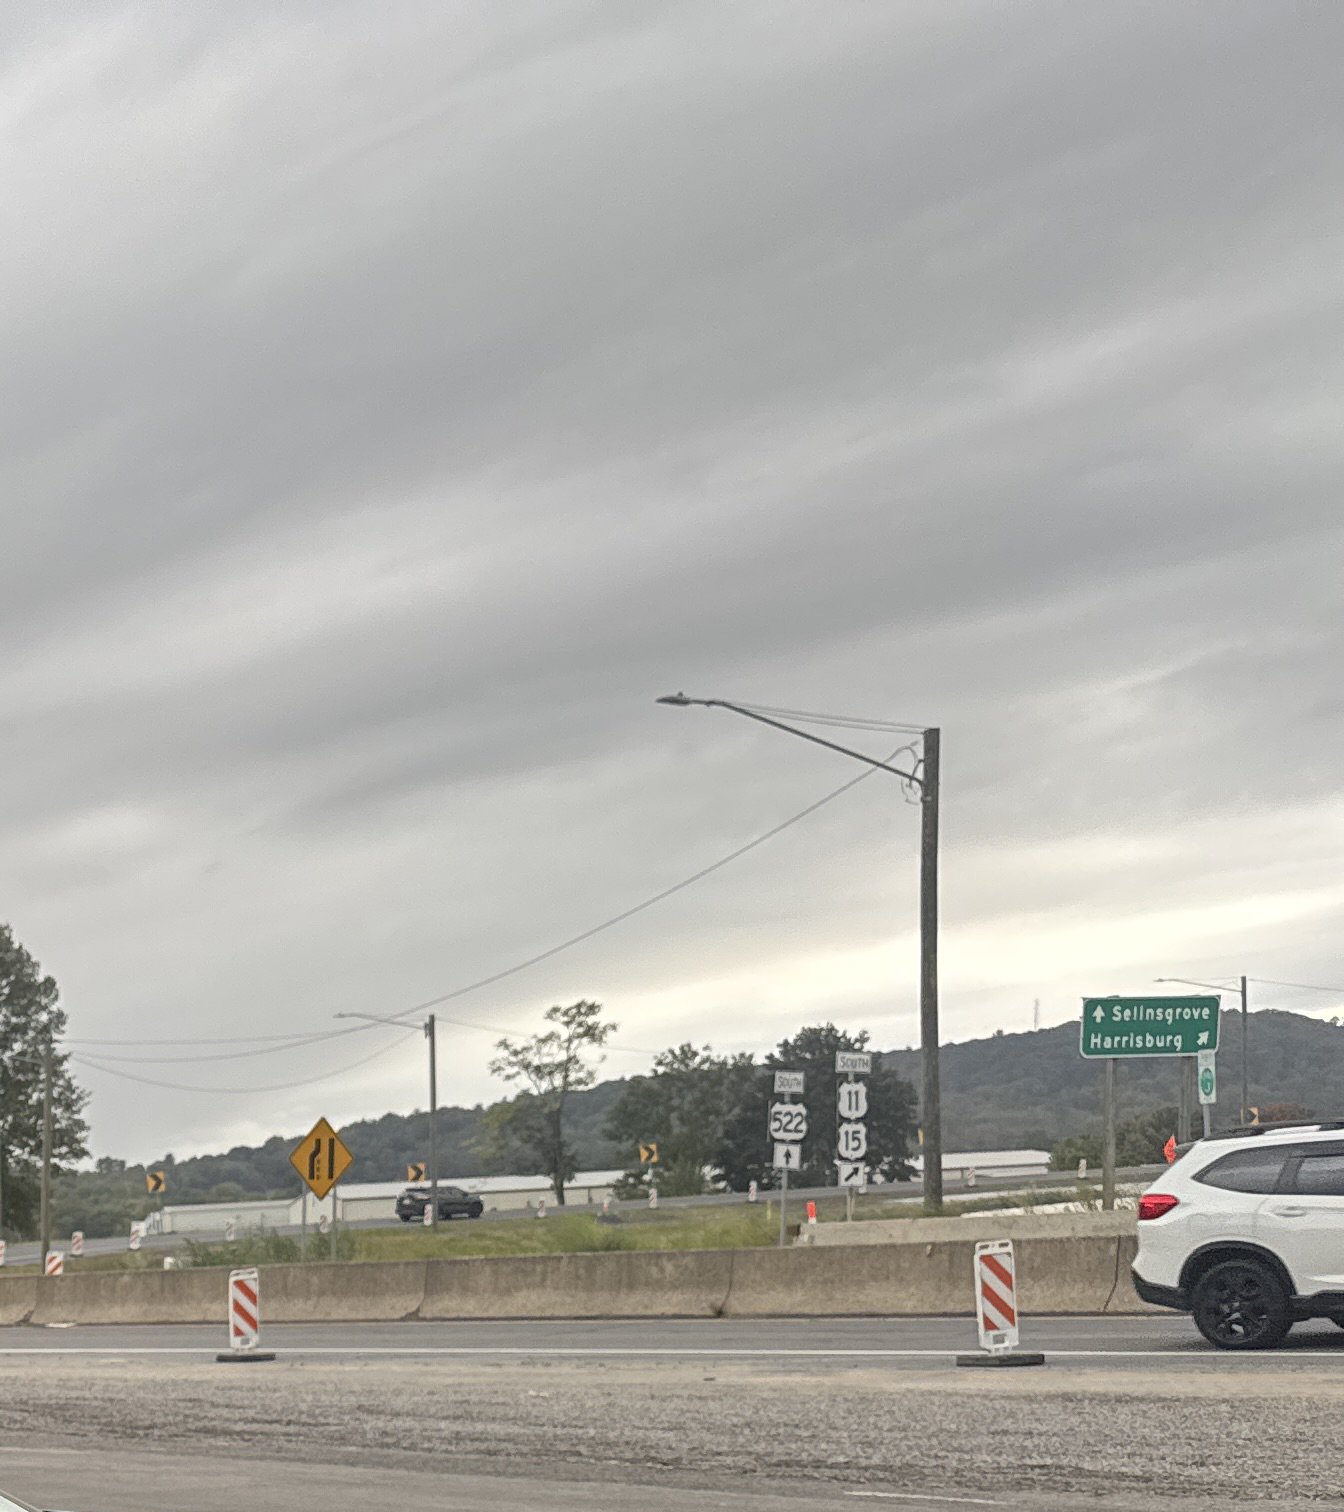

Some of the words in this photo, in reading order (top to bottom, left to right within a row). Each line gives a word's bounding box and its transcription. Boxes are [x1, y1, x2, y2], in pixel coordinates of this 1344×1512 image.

[1112, 1005, 1211, 1025] Selinsgrove
[1090, 1032, 1183, 1051] Harrisburg
[839, 1057, 869, 1069] SOUTH
[777, 1075, 802, 1089] SOUTH
[847, 1090, 860, 1112] 11
[772, 1111, 804, 1134] 522
[844, 1130, 862, 1152] 15
